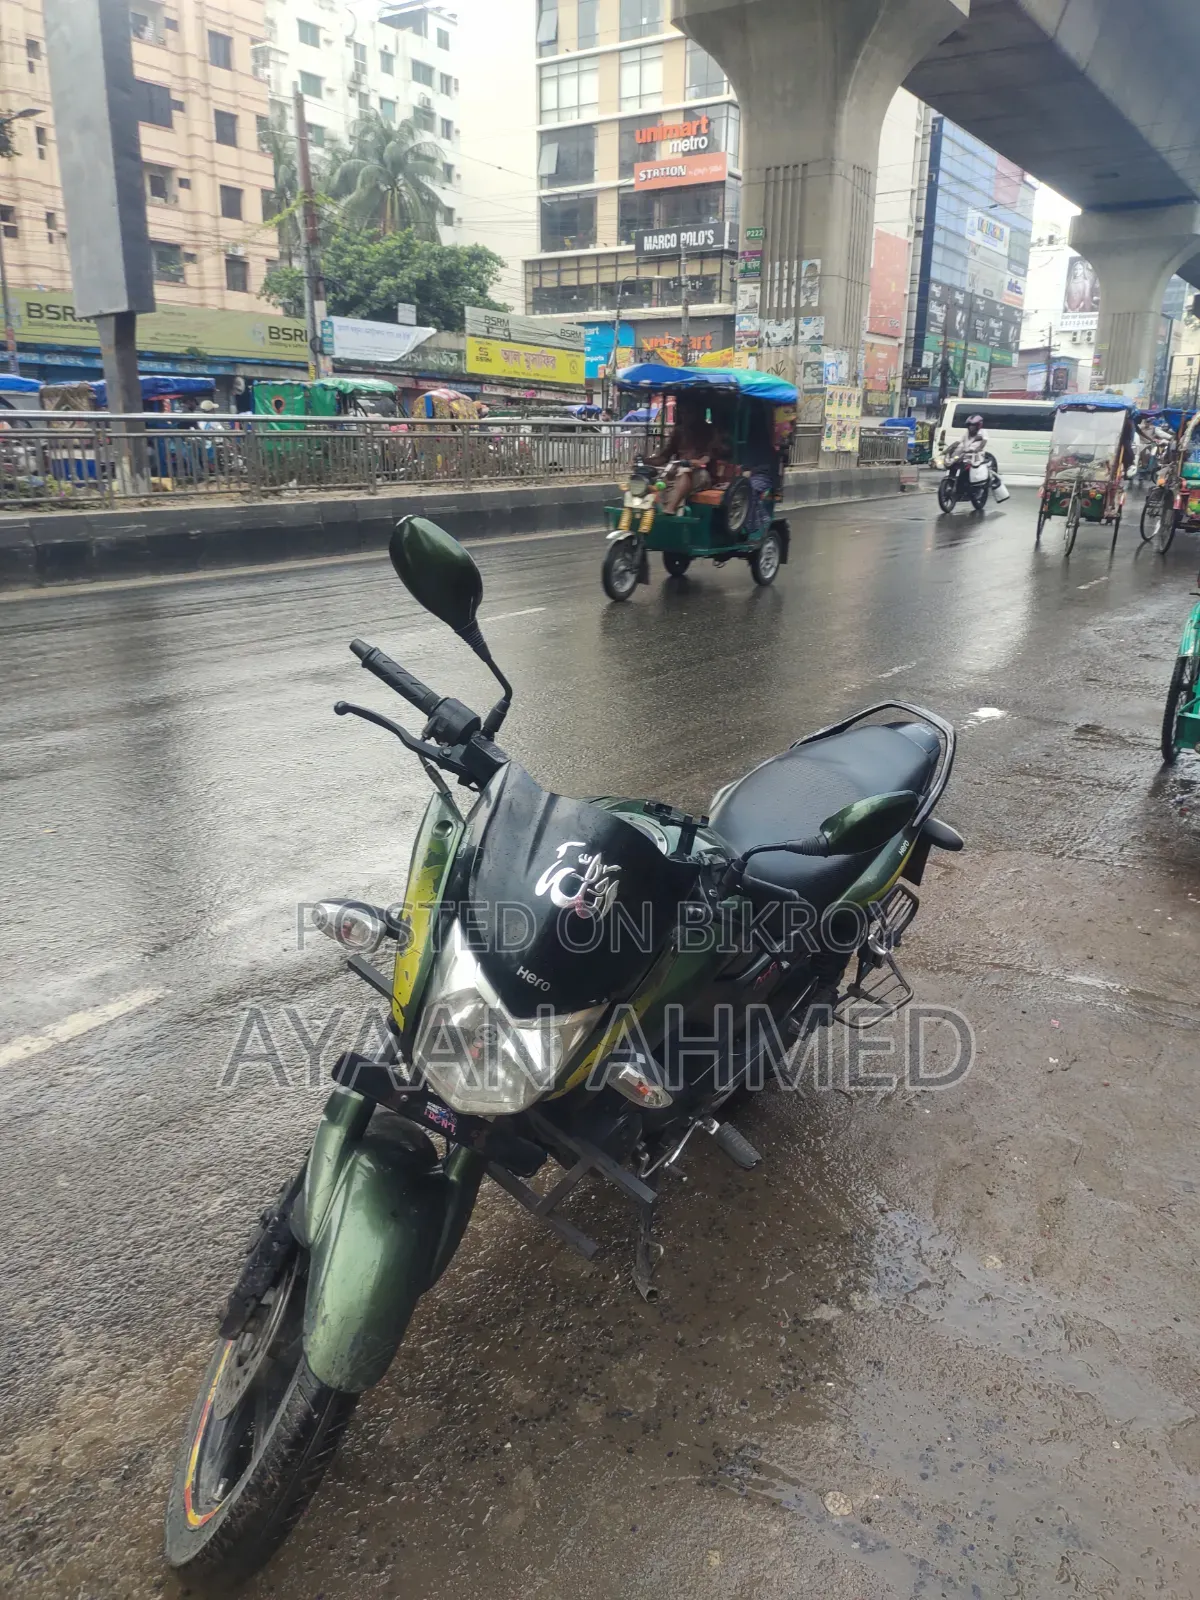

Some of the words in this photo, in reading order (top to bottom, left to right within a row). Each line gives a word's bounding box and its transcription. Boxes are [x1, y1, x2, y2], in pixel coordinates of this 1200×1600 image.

[635, 115, 709, 143] unimart
[669, 136, 708, 153] metro
[639, 165, 687, 181] STATION
[643, 235, 677, 251] MARCO
[26, 302, 96, 323] BSR
[484, 315, 510, 329] BSRM
[268, 326, 308, 342] BSR
[516, 965, 551, 992] Hero
